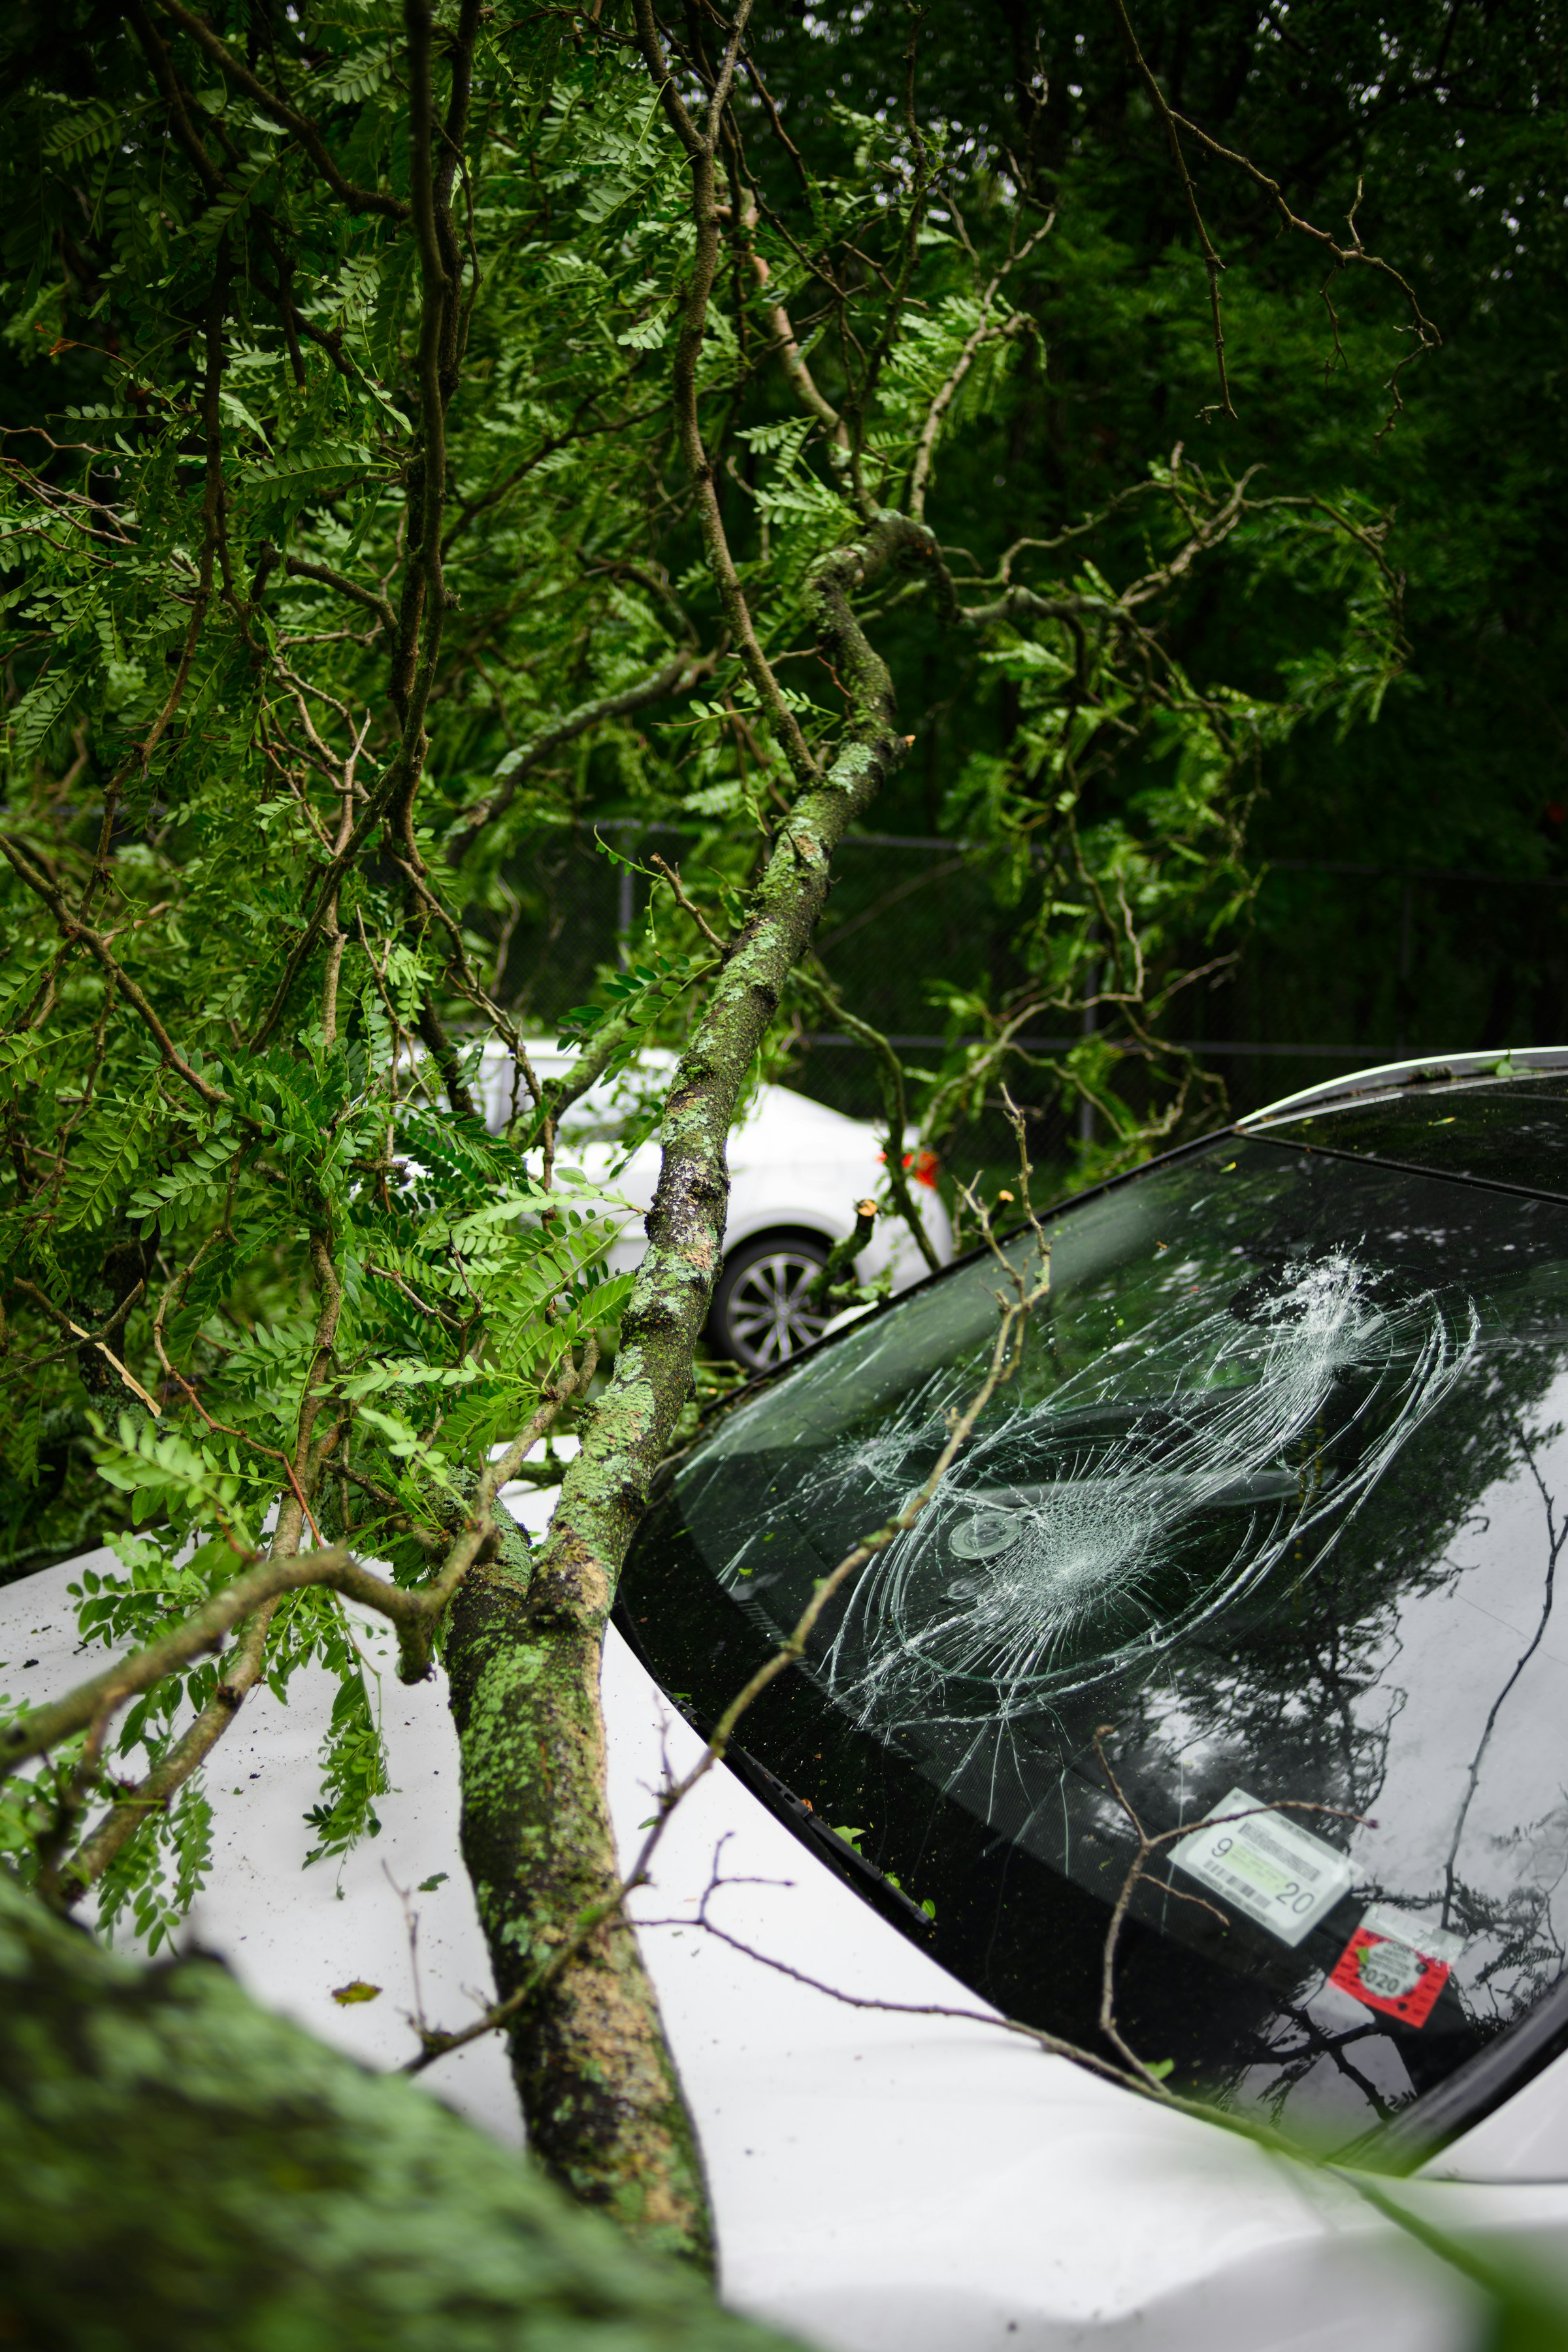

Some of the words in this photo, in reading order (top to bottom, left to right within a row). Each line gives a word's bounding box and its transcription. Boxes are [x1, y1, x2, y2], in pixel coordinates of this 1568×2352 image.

[1211, 1837, 1233, 1858] 9
[1275, 1882, 1315, 1914] 20
[1354, 1964, 1399, 1993] 2020
